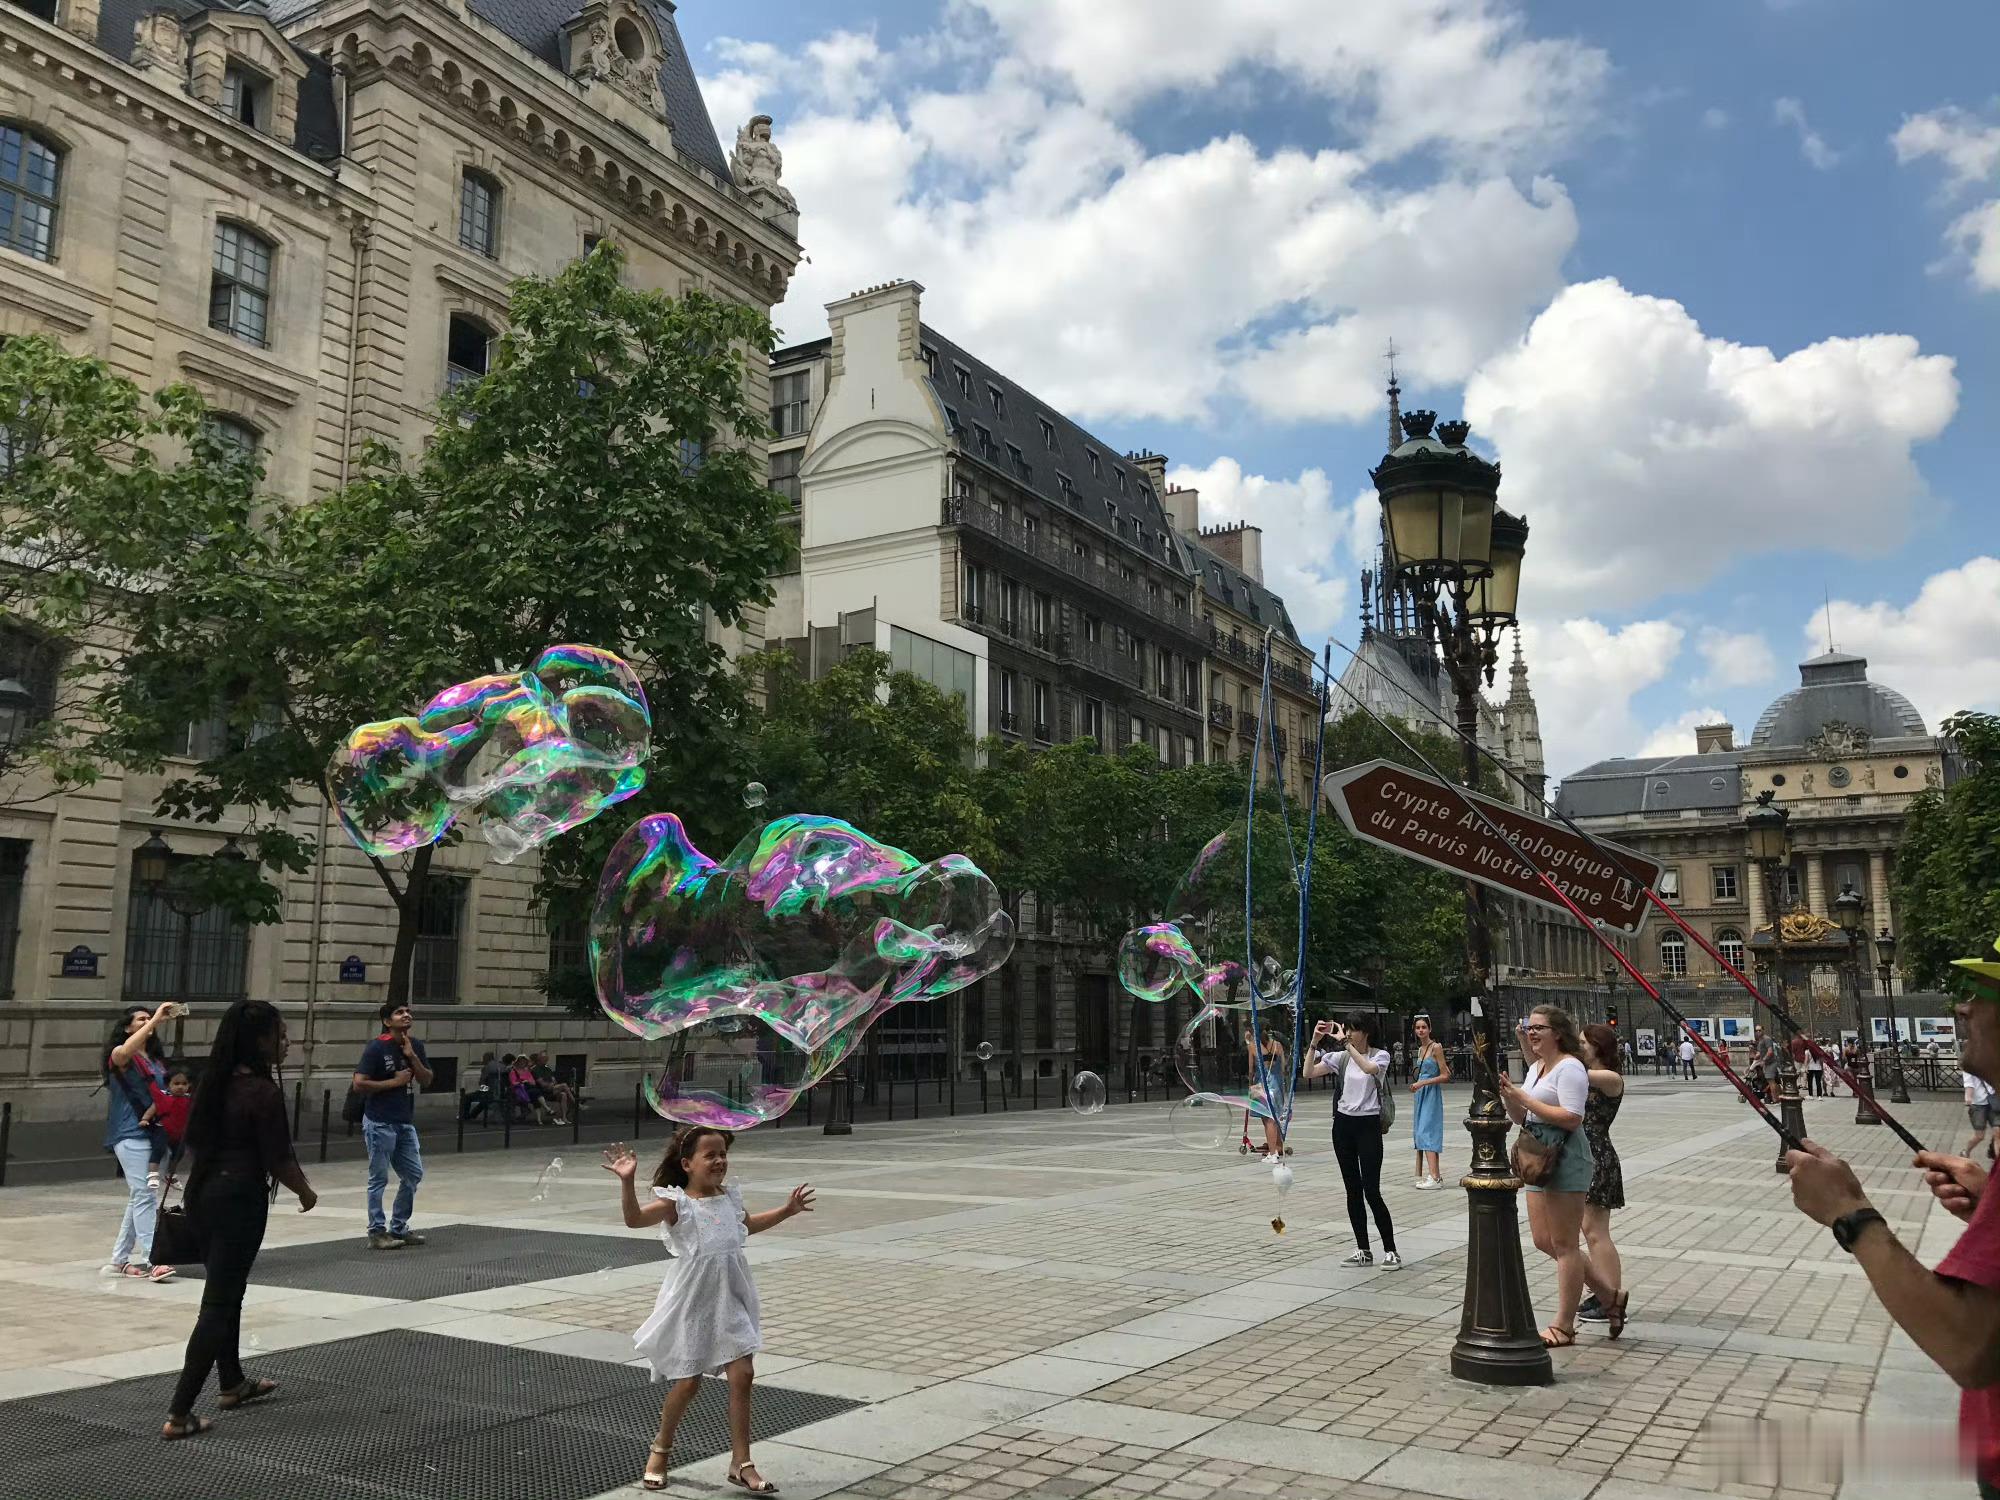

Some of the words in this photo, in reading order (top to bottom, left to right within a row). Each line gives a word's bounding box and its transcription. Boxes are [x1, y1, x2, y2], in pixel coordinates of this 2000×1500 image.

[1380, 782, 1450, 819] Crypte
[1371, 809, 1397, 830] du
[1401, 819, 1467, 856] Parvis
[1473, 846, 1533, 880] Notre
